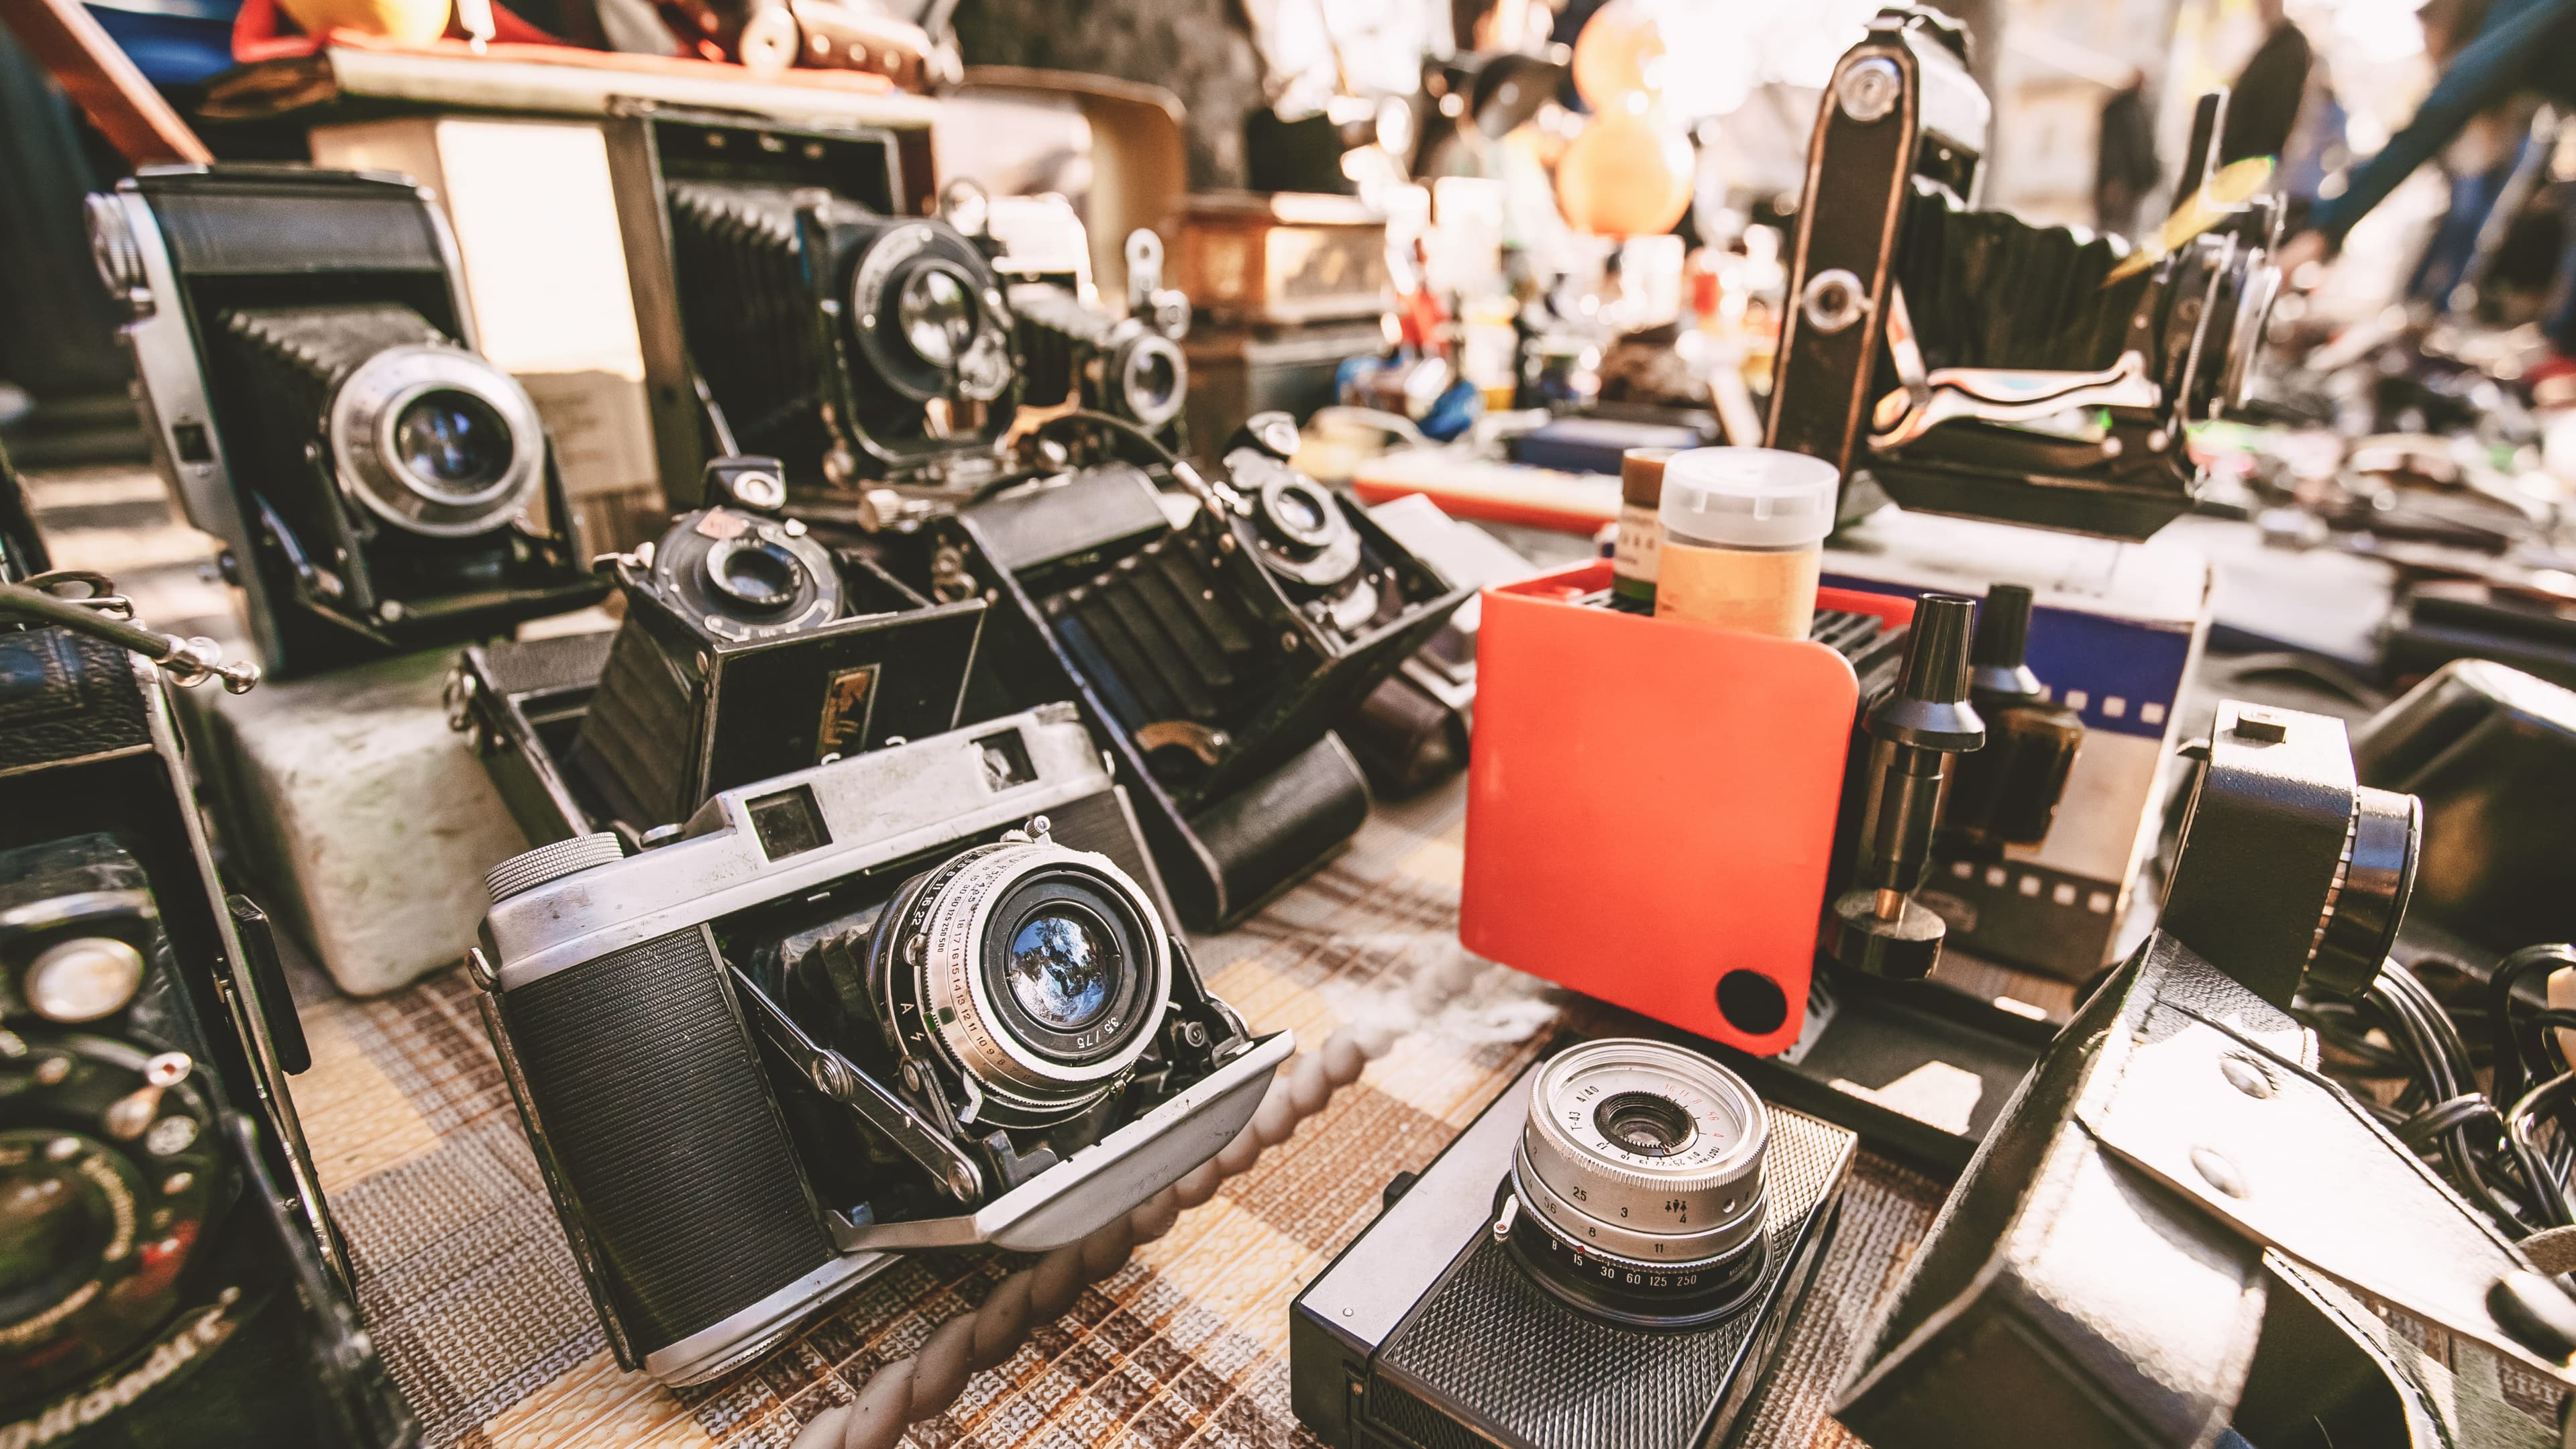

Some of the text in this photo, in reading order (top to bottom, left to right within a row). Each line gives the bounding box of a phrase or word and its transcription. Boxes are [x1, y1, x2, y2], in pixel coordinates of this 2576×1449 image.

[922, 896, 934, 907] 16
[951, 896, 962, 907] 60
[911, 911, 925, 926] 22
[945, 908, 955, 924] 125
[957, 918, 966, 929] 18
[940, 922, 950, 938] 250
[953, 932, 962, 944] 17
[937, 938, 946, 953] 500
[951, 947, 960, 959] 16
[951, 963, 959, 975] 15
[953, 978, 961, 991] 14
[956, 994, 965, 1006] 13
[900, 1003, 915, 1015] A
[961, 1008, 971, 1021] 12
[967, 1022, 977, 1032] 11
[976, 1036, 987, 1047] 10
[986, 1048, 995, 1056] 9
[1576, 1085, 1599, 1106] 4/40
[1620, 1206, 1629, 1218] 3
[1679, 1213, 1687, 1224] 4
[1588, 1226, 1597, 1238] 8
[1654, 1242, 1664, 1254] 11
[1572, 1254, 1584, 1267] 15
[1600, 1266, 1615, 1279] 30
[1626, 1273, 1642, 1285] 60
[1650, 1276, 1668, 1287] 125
[1676, 1275, 1697, 1287] 250
